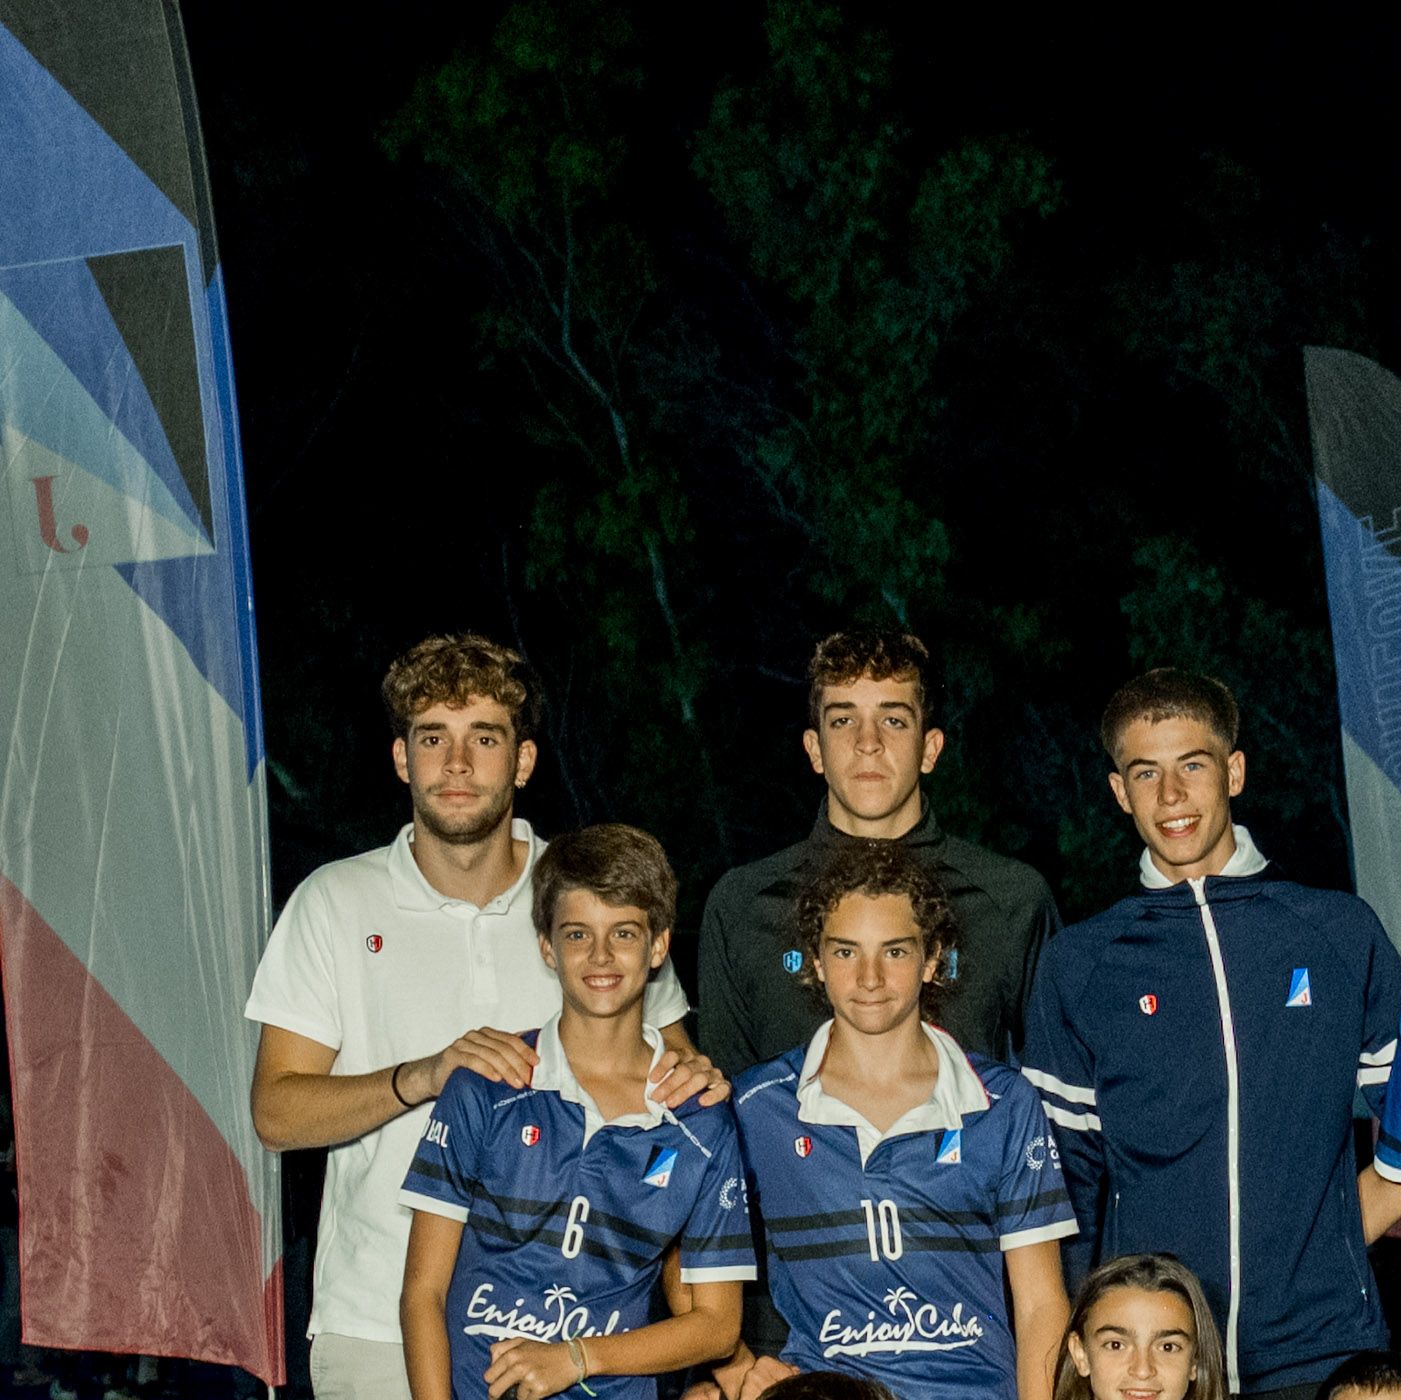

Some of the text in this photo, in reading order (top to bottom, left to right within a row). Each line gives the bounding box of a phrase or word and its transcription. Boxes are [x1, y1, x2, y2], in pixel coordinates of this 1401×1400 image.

[561, 1196, 588, 1260] 6
[861, 1199, 904, 1262] 10
[467, 1284, 560, 1338] Enjoy
[819, 1302, 983, 1345] Enjoy Cuba
